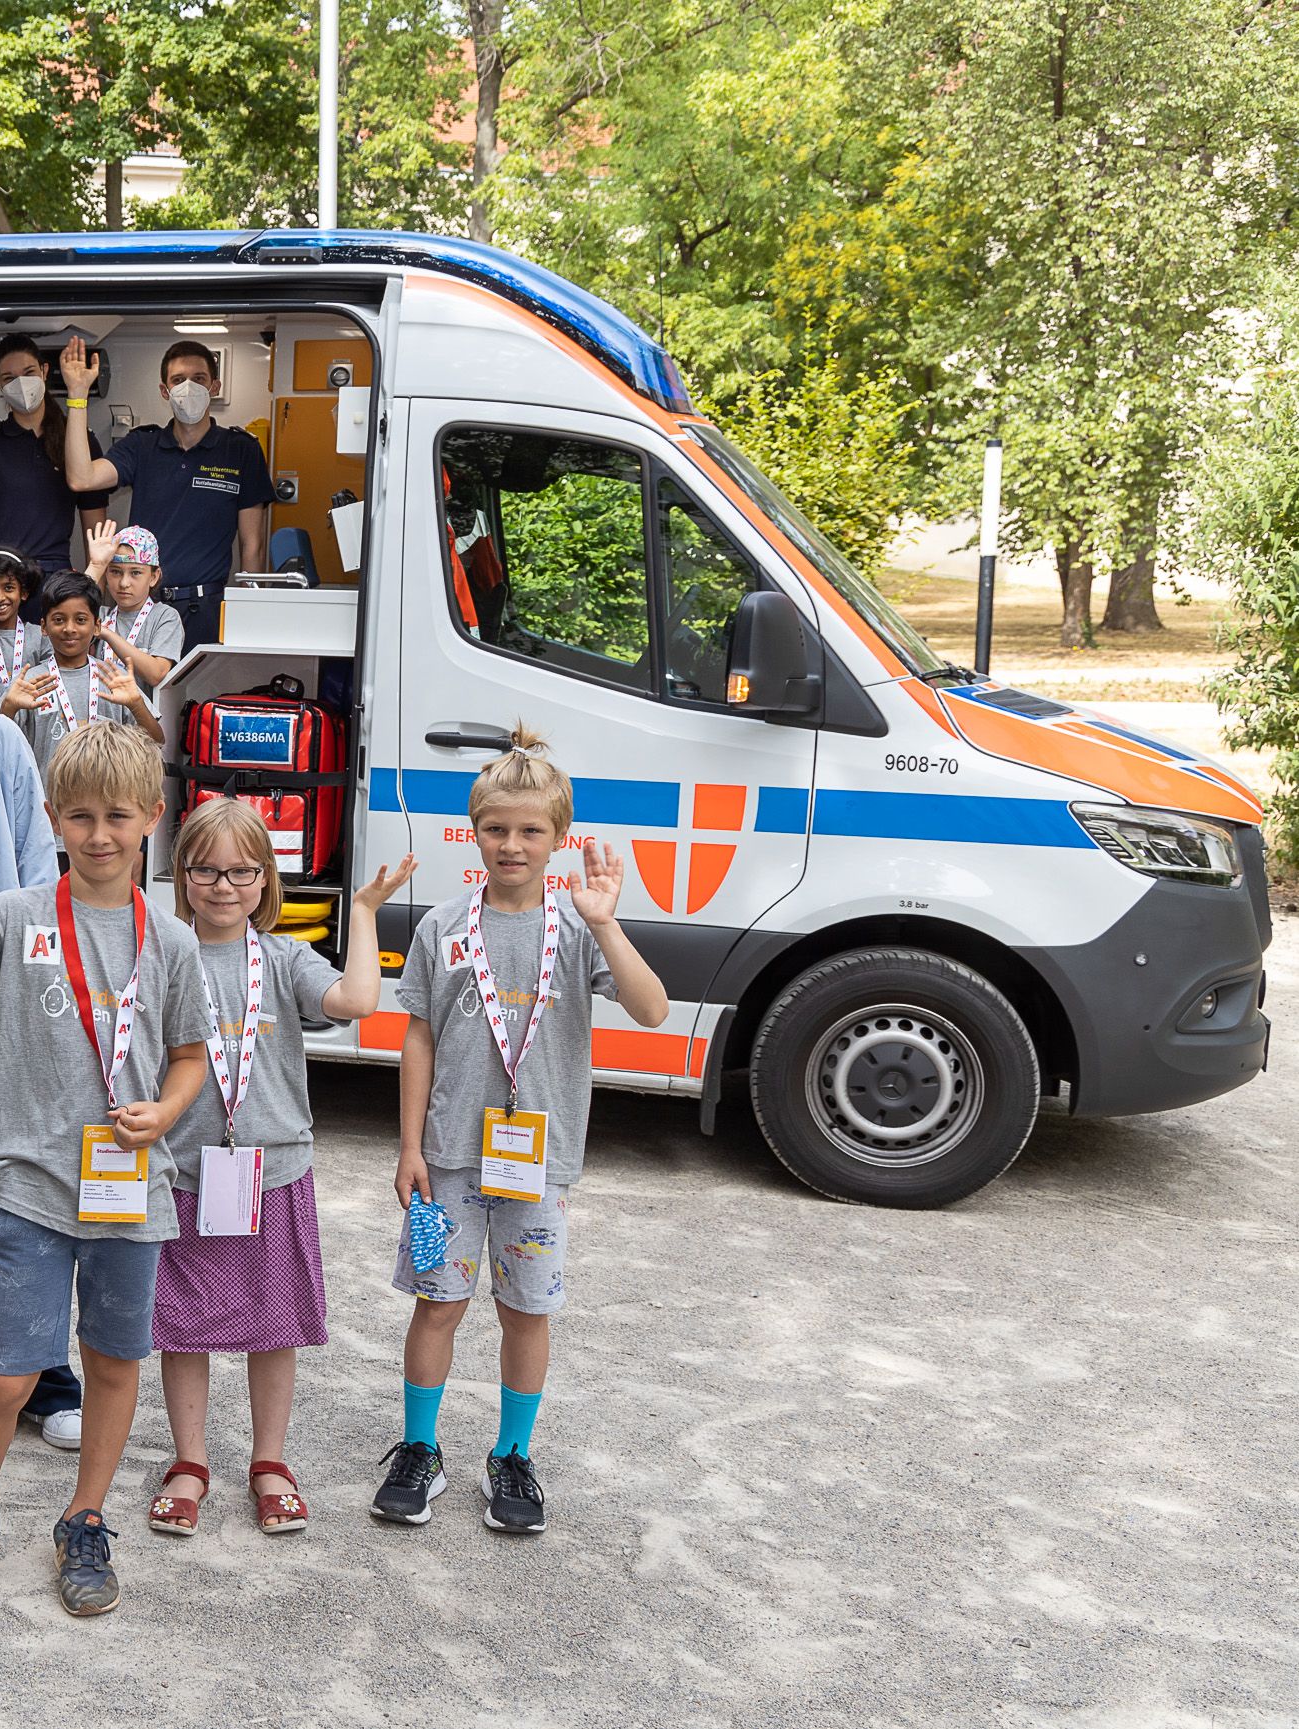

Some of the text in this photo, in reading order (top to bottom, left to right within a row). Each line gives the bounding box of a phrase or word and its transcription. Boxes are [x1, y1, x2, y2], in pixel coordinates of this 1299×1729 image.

[226, 732, 285, 744] W6386MA
[885, 754, 959, 775] 9608-70
[915, 901, 929, 909] bar
[470, 923, 478, 935] A1
[547, 924, 557, 933] A1
[30, 932, 56, 957] A1
[450, 936, 469, 966] A1
[474, 946, 483, 958] A1
[545, 947, 555, 956] A1
[250, 958, 261, 966] A1
[479, 969, 489, 981] A1
[250, 980, 260, 988] A1
[122, 997, 133, 1008] A1
[486, 992, 495, 1003] A1
[249, 1004, 259, 1012] A1
[118, 1023, 130, 1033] A1
[246, 1027, 256, 1036] A1
